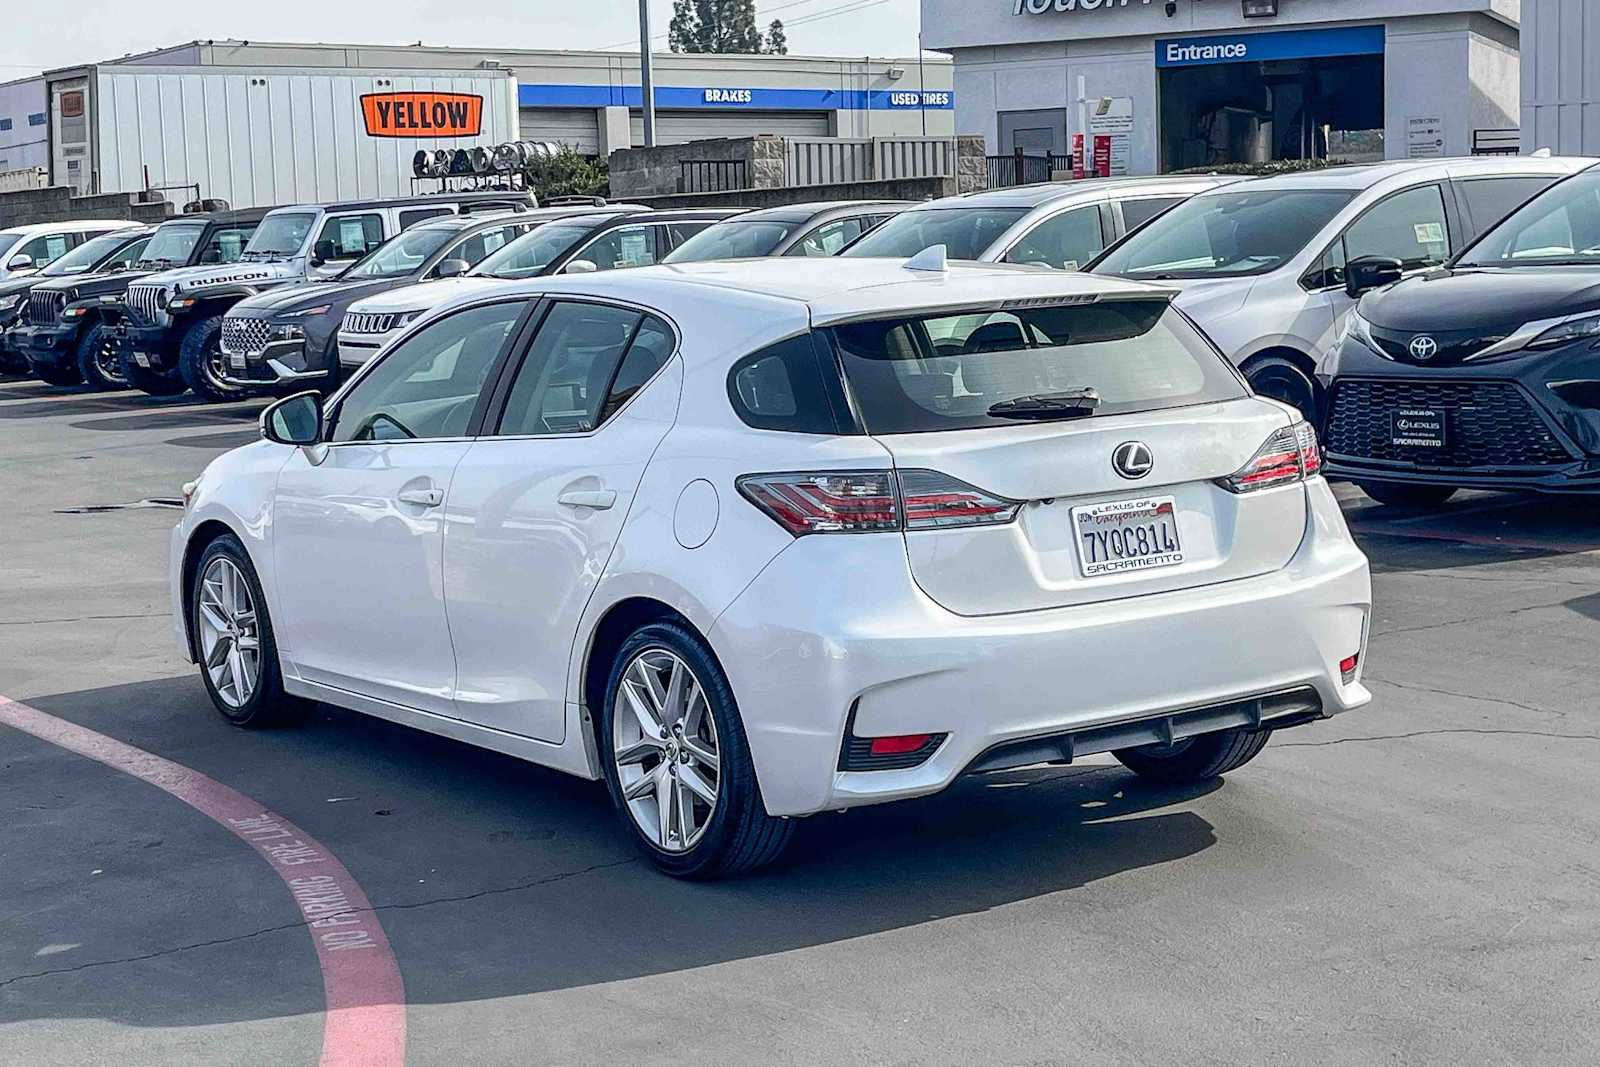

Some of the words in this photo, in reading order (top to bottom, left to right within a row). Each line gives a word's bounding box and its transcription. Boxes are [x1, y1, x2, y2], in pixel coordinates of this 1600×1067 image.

[1166, 43, 1247, 62] Entrance
[704, 88, 752, 103] BRAKES
[891, 92, 920, 106] USED
[920, 92, 949, 106] TIRES
[377, 101, 468, 129] YELLOW
[189, 271, 270, 287] RUBICON
[1409, 421, 1440, 430] LEXUS
[1096, 503, 1135, 513] LEXUS
[1135, 500, 1151, 508] OF
[1083, 522, 1175, 563] 7YQC814
[1087, 553, 1183, 574] SACRAMENTO
[262, 839, 327, 866] FIRE
[290, 875, 361, 929] PARKING
[321, 930, 377, 951] NO
